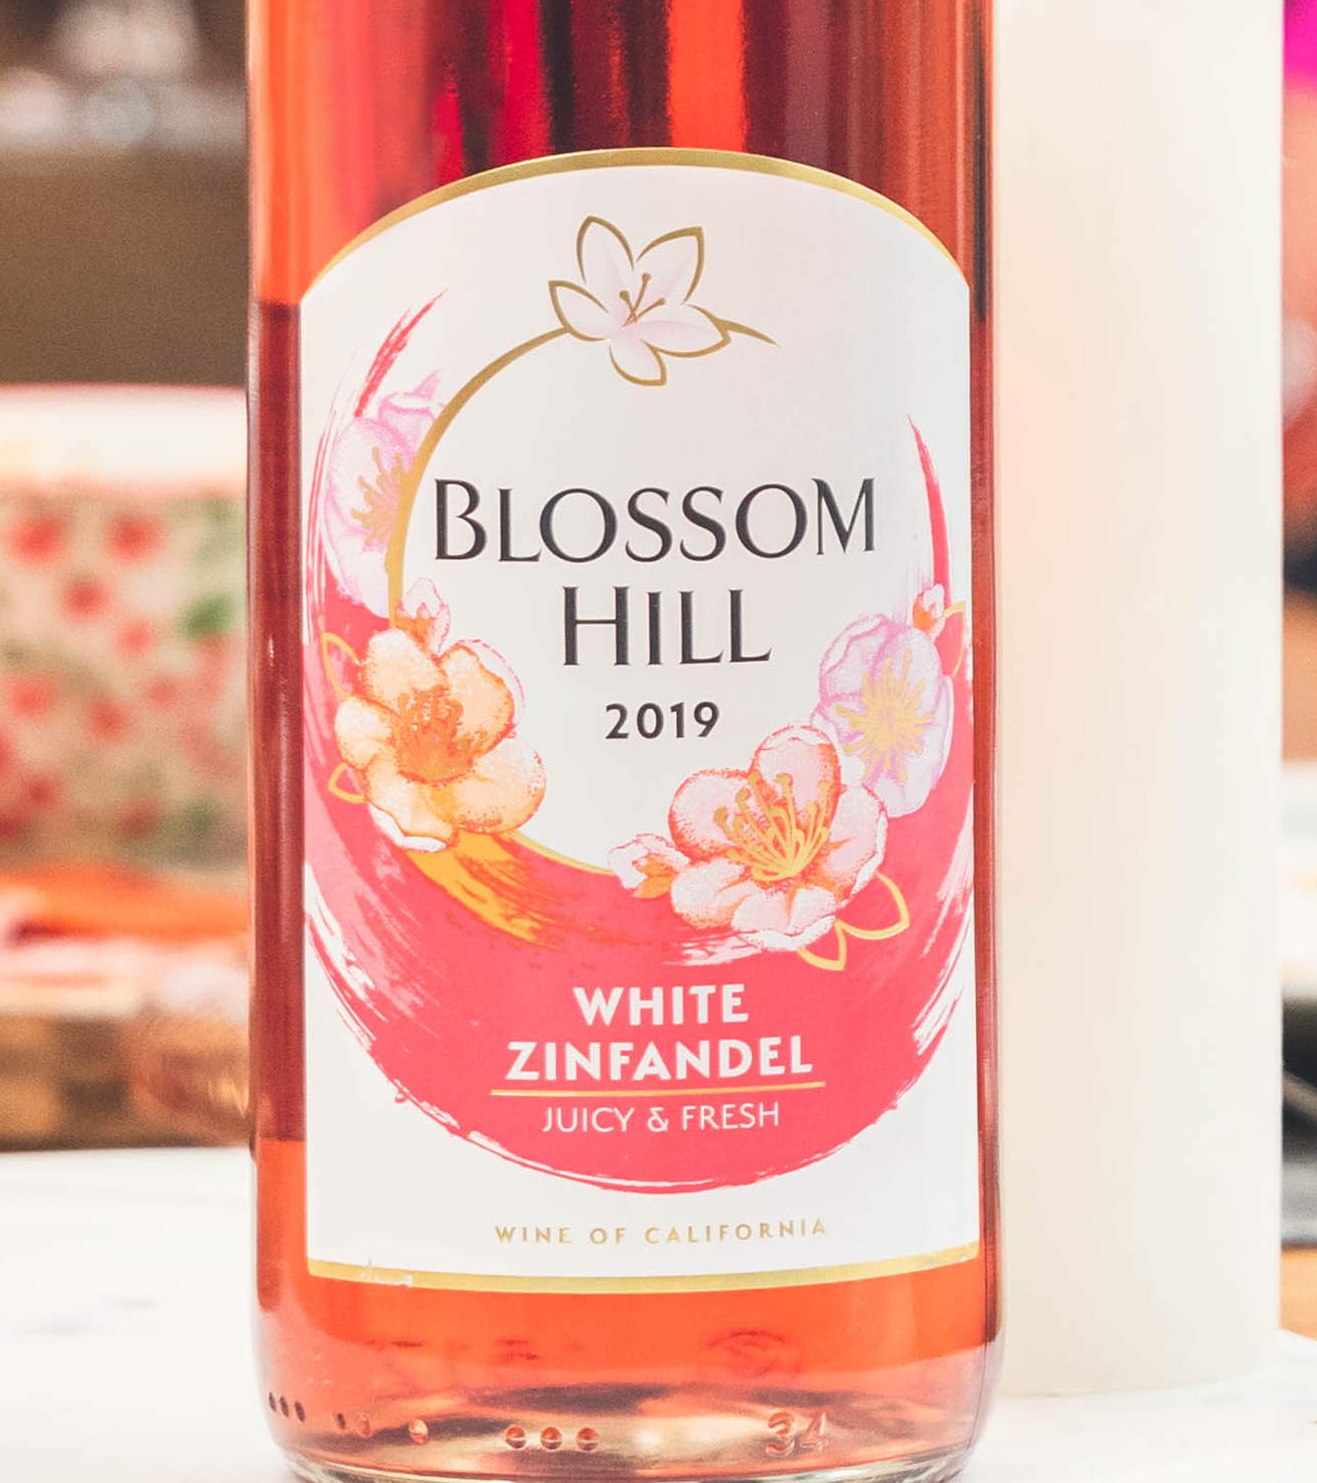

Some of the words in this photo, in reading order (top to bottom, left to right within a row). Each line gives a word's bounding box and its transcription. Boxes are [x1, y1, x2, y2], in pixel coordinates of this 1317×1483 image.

[434, 477, 875, 564] BLOSSOM
[562, 585, 772, 667] HILL
[604, 700, 720, 741] 2019
[572, 983, 749, 1026] WHITE
[505, 1035, 813, 1082] ZINFANDEL
[542, 1106, 636, 1134] JUICY
[646, 1106, 670, 1134] &
[682, 1100, 780, 1131] FRESH
[494, 1225, 572, 1245] WINE
[589, 1226, 627, 1246] OF
[643, 1217, 827, 1246] CALIFORNIA
[765, 1410, 829, 1457] 34
